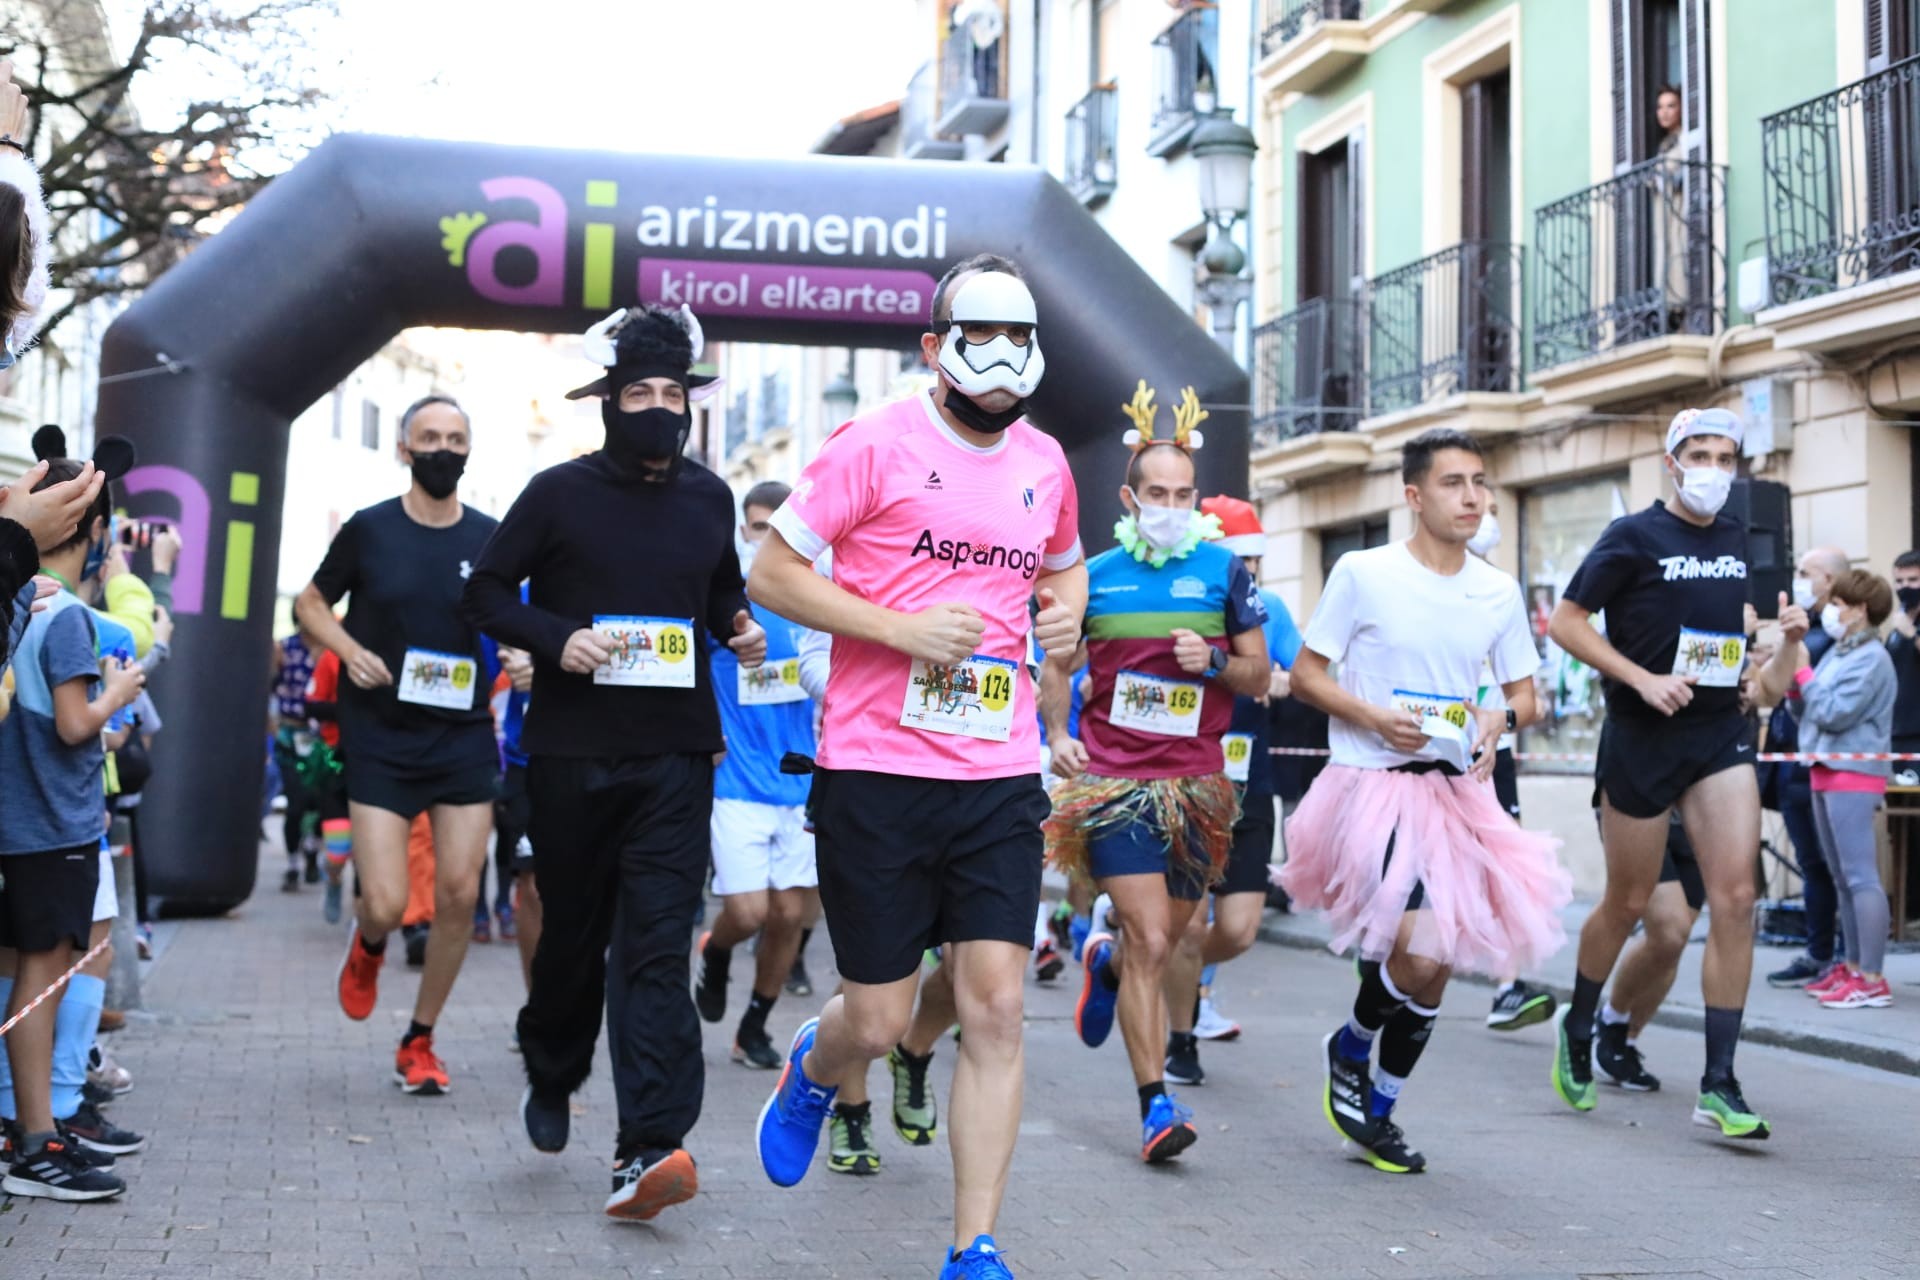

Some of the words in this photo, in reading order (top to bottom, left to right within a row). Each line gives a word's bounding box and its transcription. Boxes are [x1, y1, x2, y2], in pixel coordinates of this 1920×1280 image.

[637, 195, 947, 259] arizmendi
[661, 269, 749, 306] kirol
[761, 276, 921, 315] elkartea
[659, 633, 687, 655] 183
[913, 676, 933, 688] SAN
[983, 673, 1010, 702] 174
[1169, 690, 1198, 709] 162
[1445, 710, 1466, 729] 160
